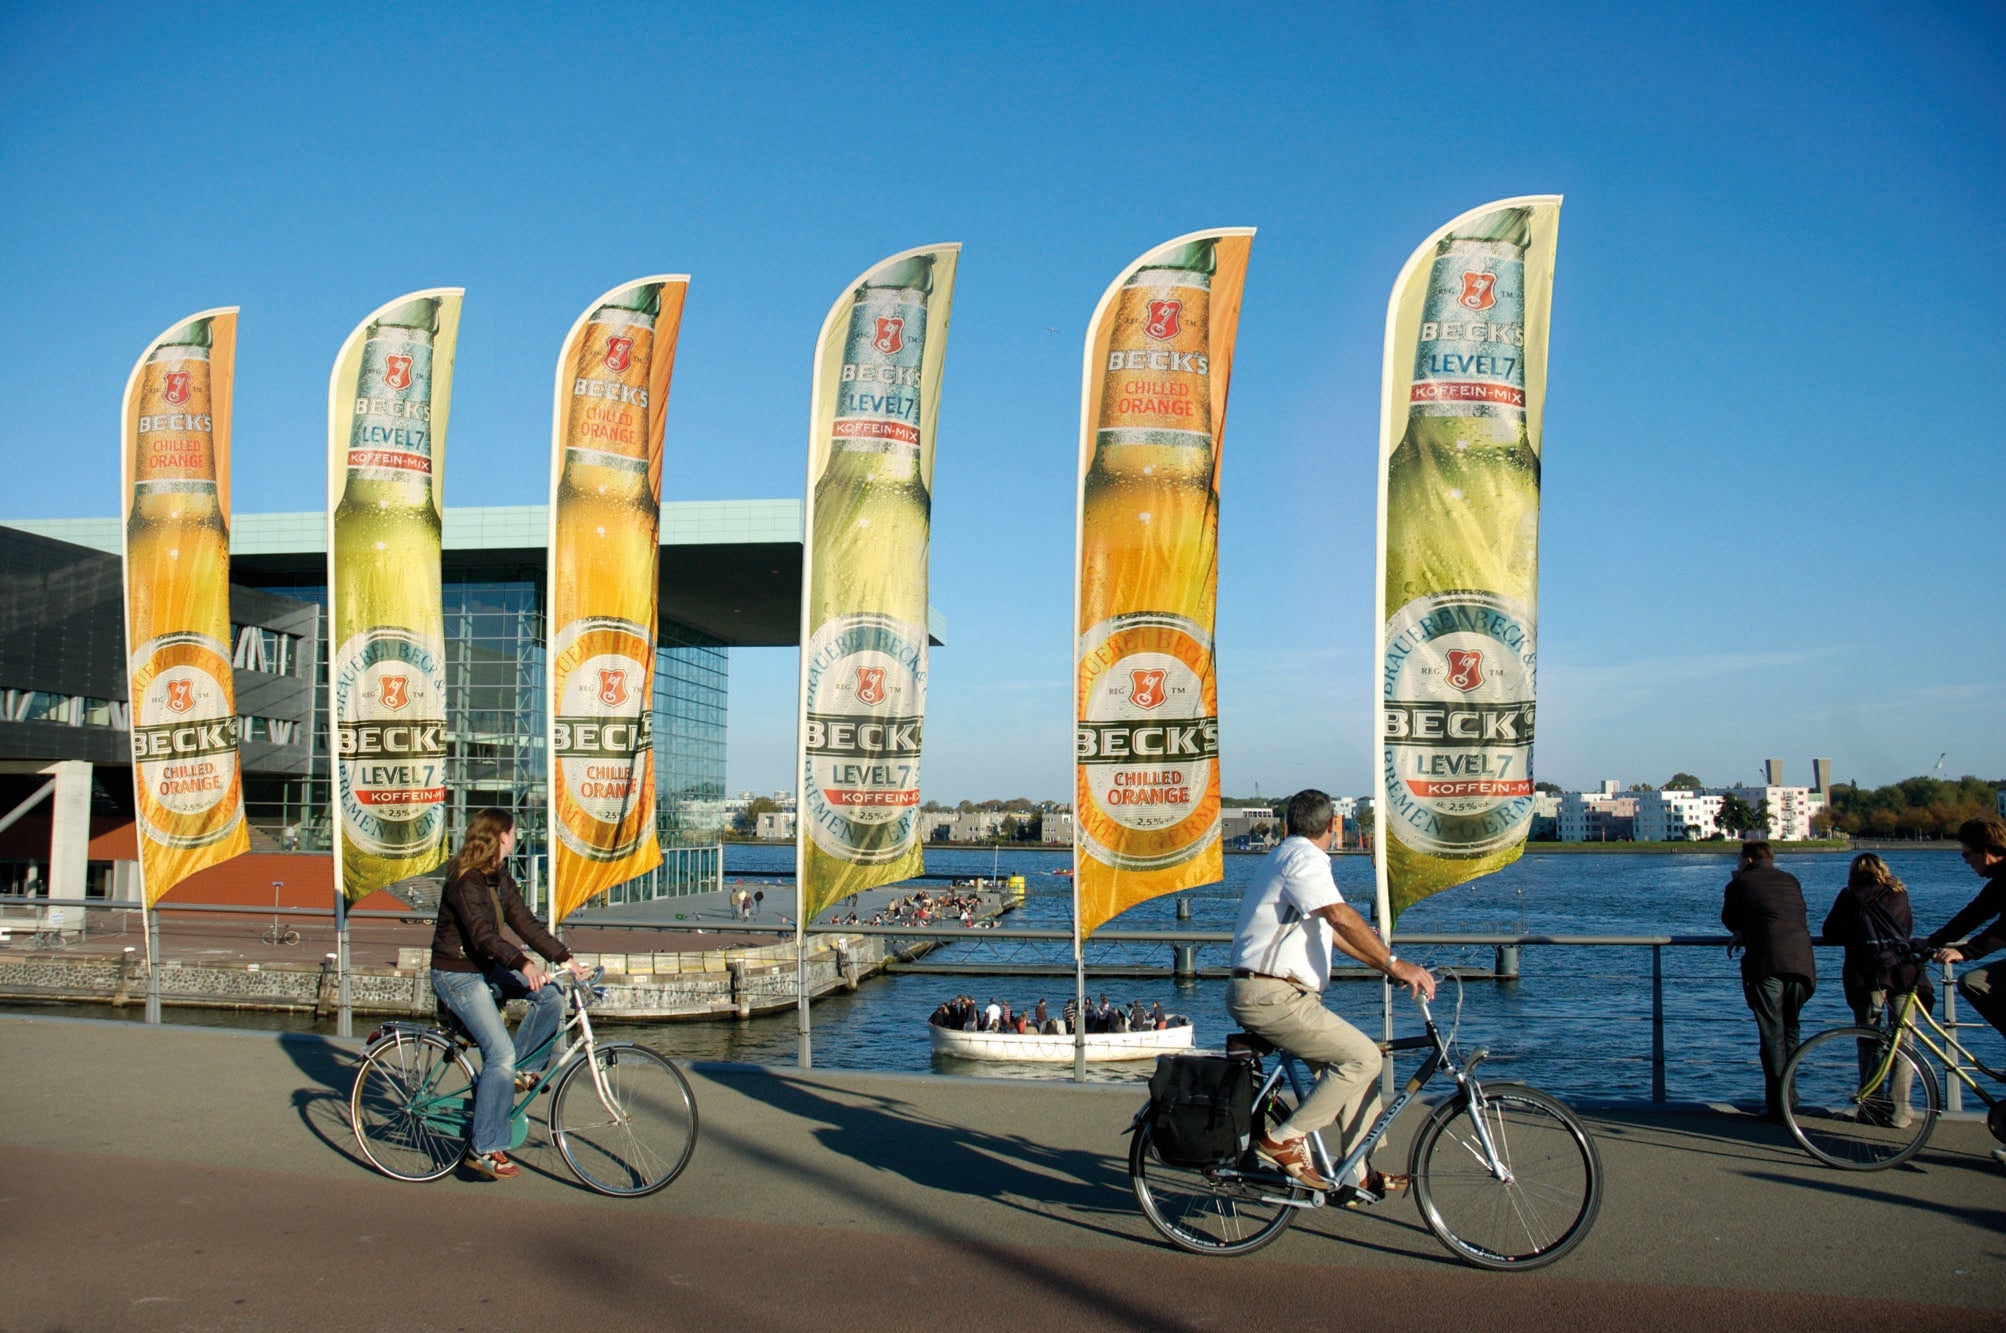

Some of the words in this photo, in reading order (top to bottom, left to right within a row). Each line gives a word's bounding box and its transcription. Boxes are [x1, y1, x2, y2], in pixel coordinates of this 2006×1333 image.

[1109, 350, 1209, 375] BECK'S
[574, 377, 648, 408] BECK'S
[1126, 381, 1189, 397] CHILLED
[1415, 385, 1522, 404] KOFFEIN-MIX
[586, 406, 633, 427] CHILLED
[1118, 398, 1194, 416] ORANGE
[139, 414, 212, 433] BECK'S
[837, 423, 917, 442] KOFFEIN-MIX
[580, 422, 636, 445] ORANGE
[153, 440, 200, 452] CHILLED
[150, 454, 204, 468] ORANGE
[351, 452, 430, 471] KOFFEIN-MIX
[806, 719, 922, 751] BECK'
[1078, 719, 1218, 756] BECK'S
[163, 762, 215, 779] CHILLED
[587, 765, 633, 780] CHILLE
[1114, 770, 1183, 786] CHILLED
[160, 776, 222, 795] ORANGE
[581, 778, 637, 799] ORANE
[1385, 751, 1444, 836] BREMEN
[1459, 794, 1533, 839] GERM
[1428, 783, 1532, 794] KOFFEIN-M
[372, 790, 444, 802] KOFFEIN-MI
[842, 790, 918, 803] KOFFEIN-
[1107, 787, 1190, 805] ORANGE
